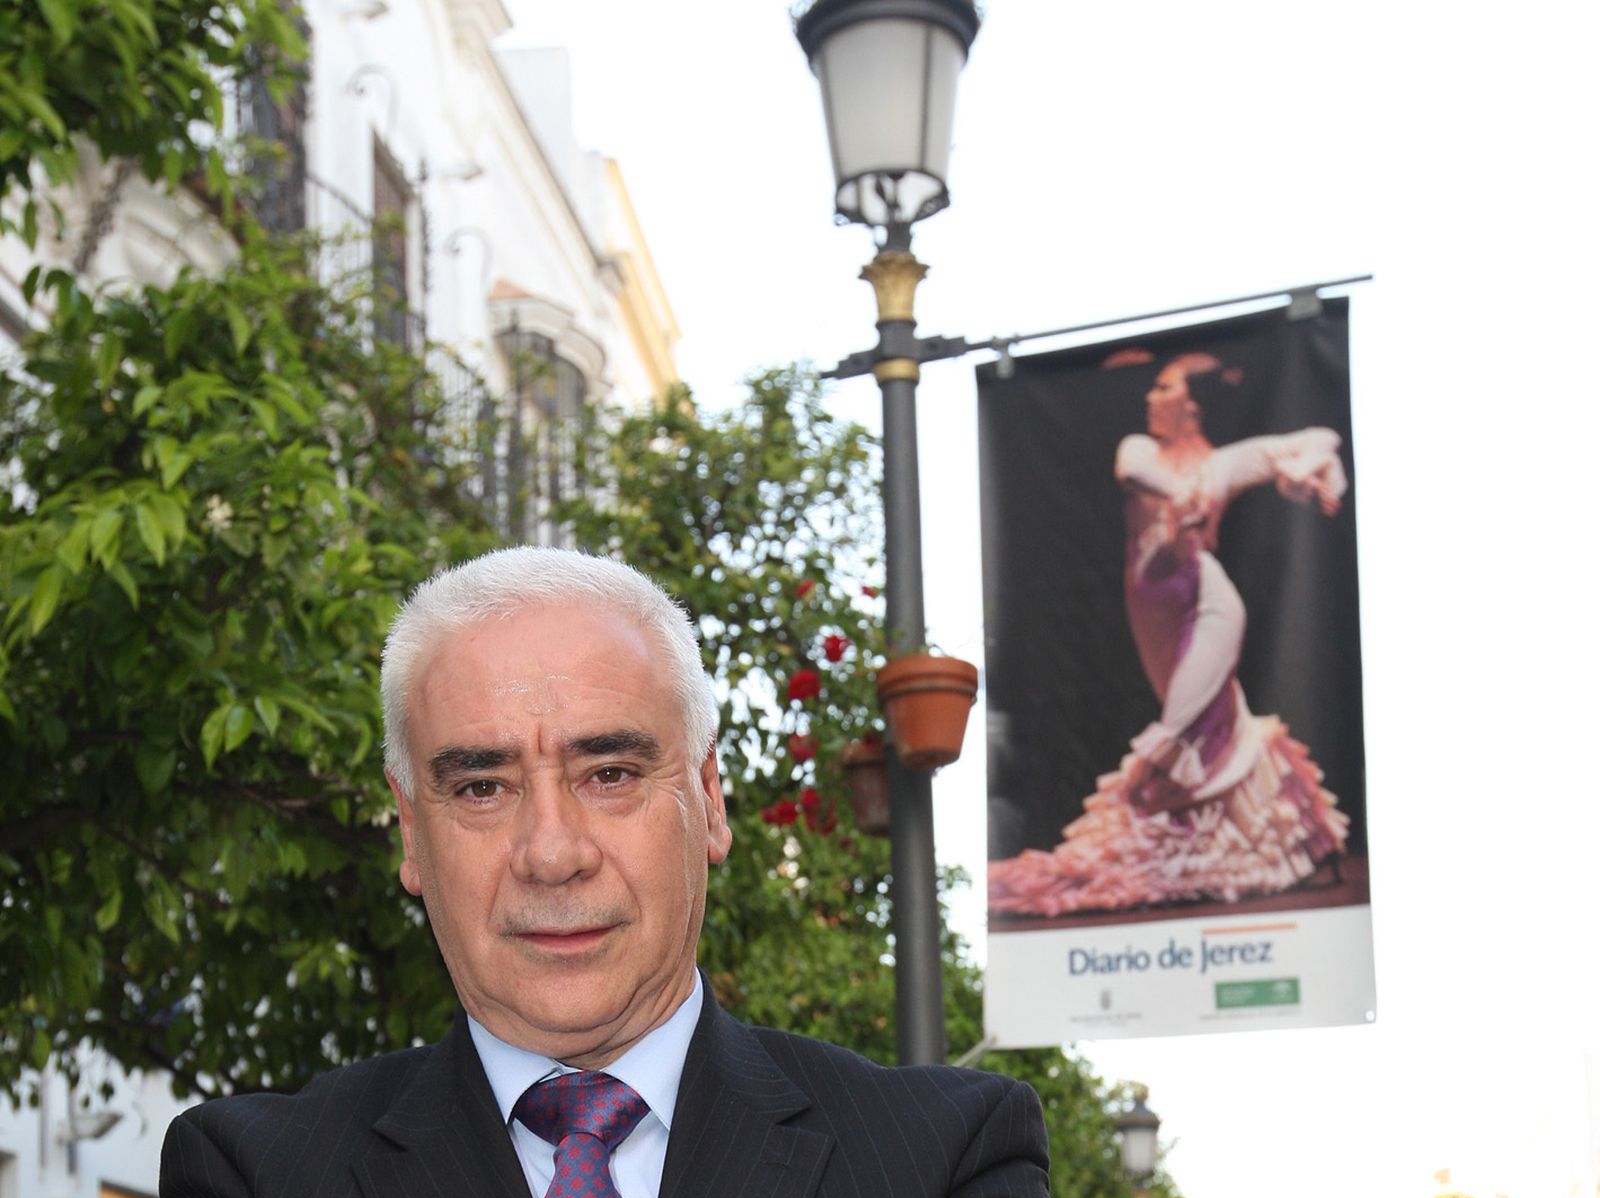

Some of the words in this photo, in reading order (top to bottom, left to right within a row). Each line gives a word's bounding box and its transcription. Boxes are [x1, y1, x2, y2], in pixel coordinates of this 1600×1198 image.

[1068, 944, 1151, 976] Diario
[1157, 937, 1194, 970] de
[1200, 938, 1273, 974] Jerez
